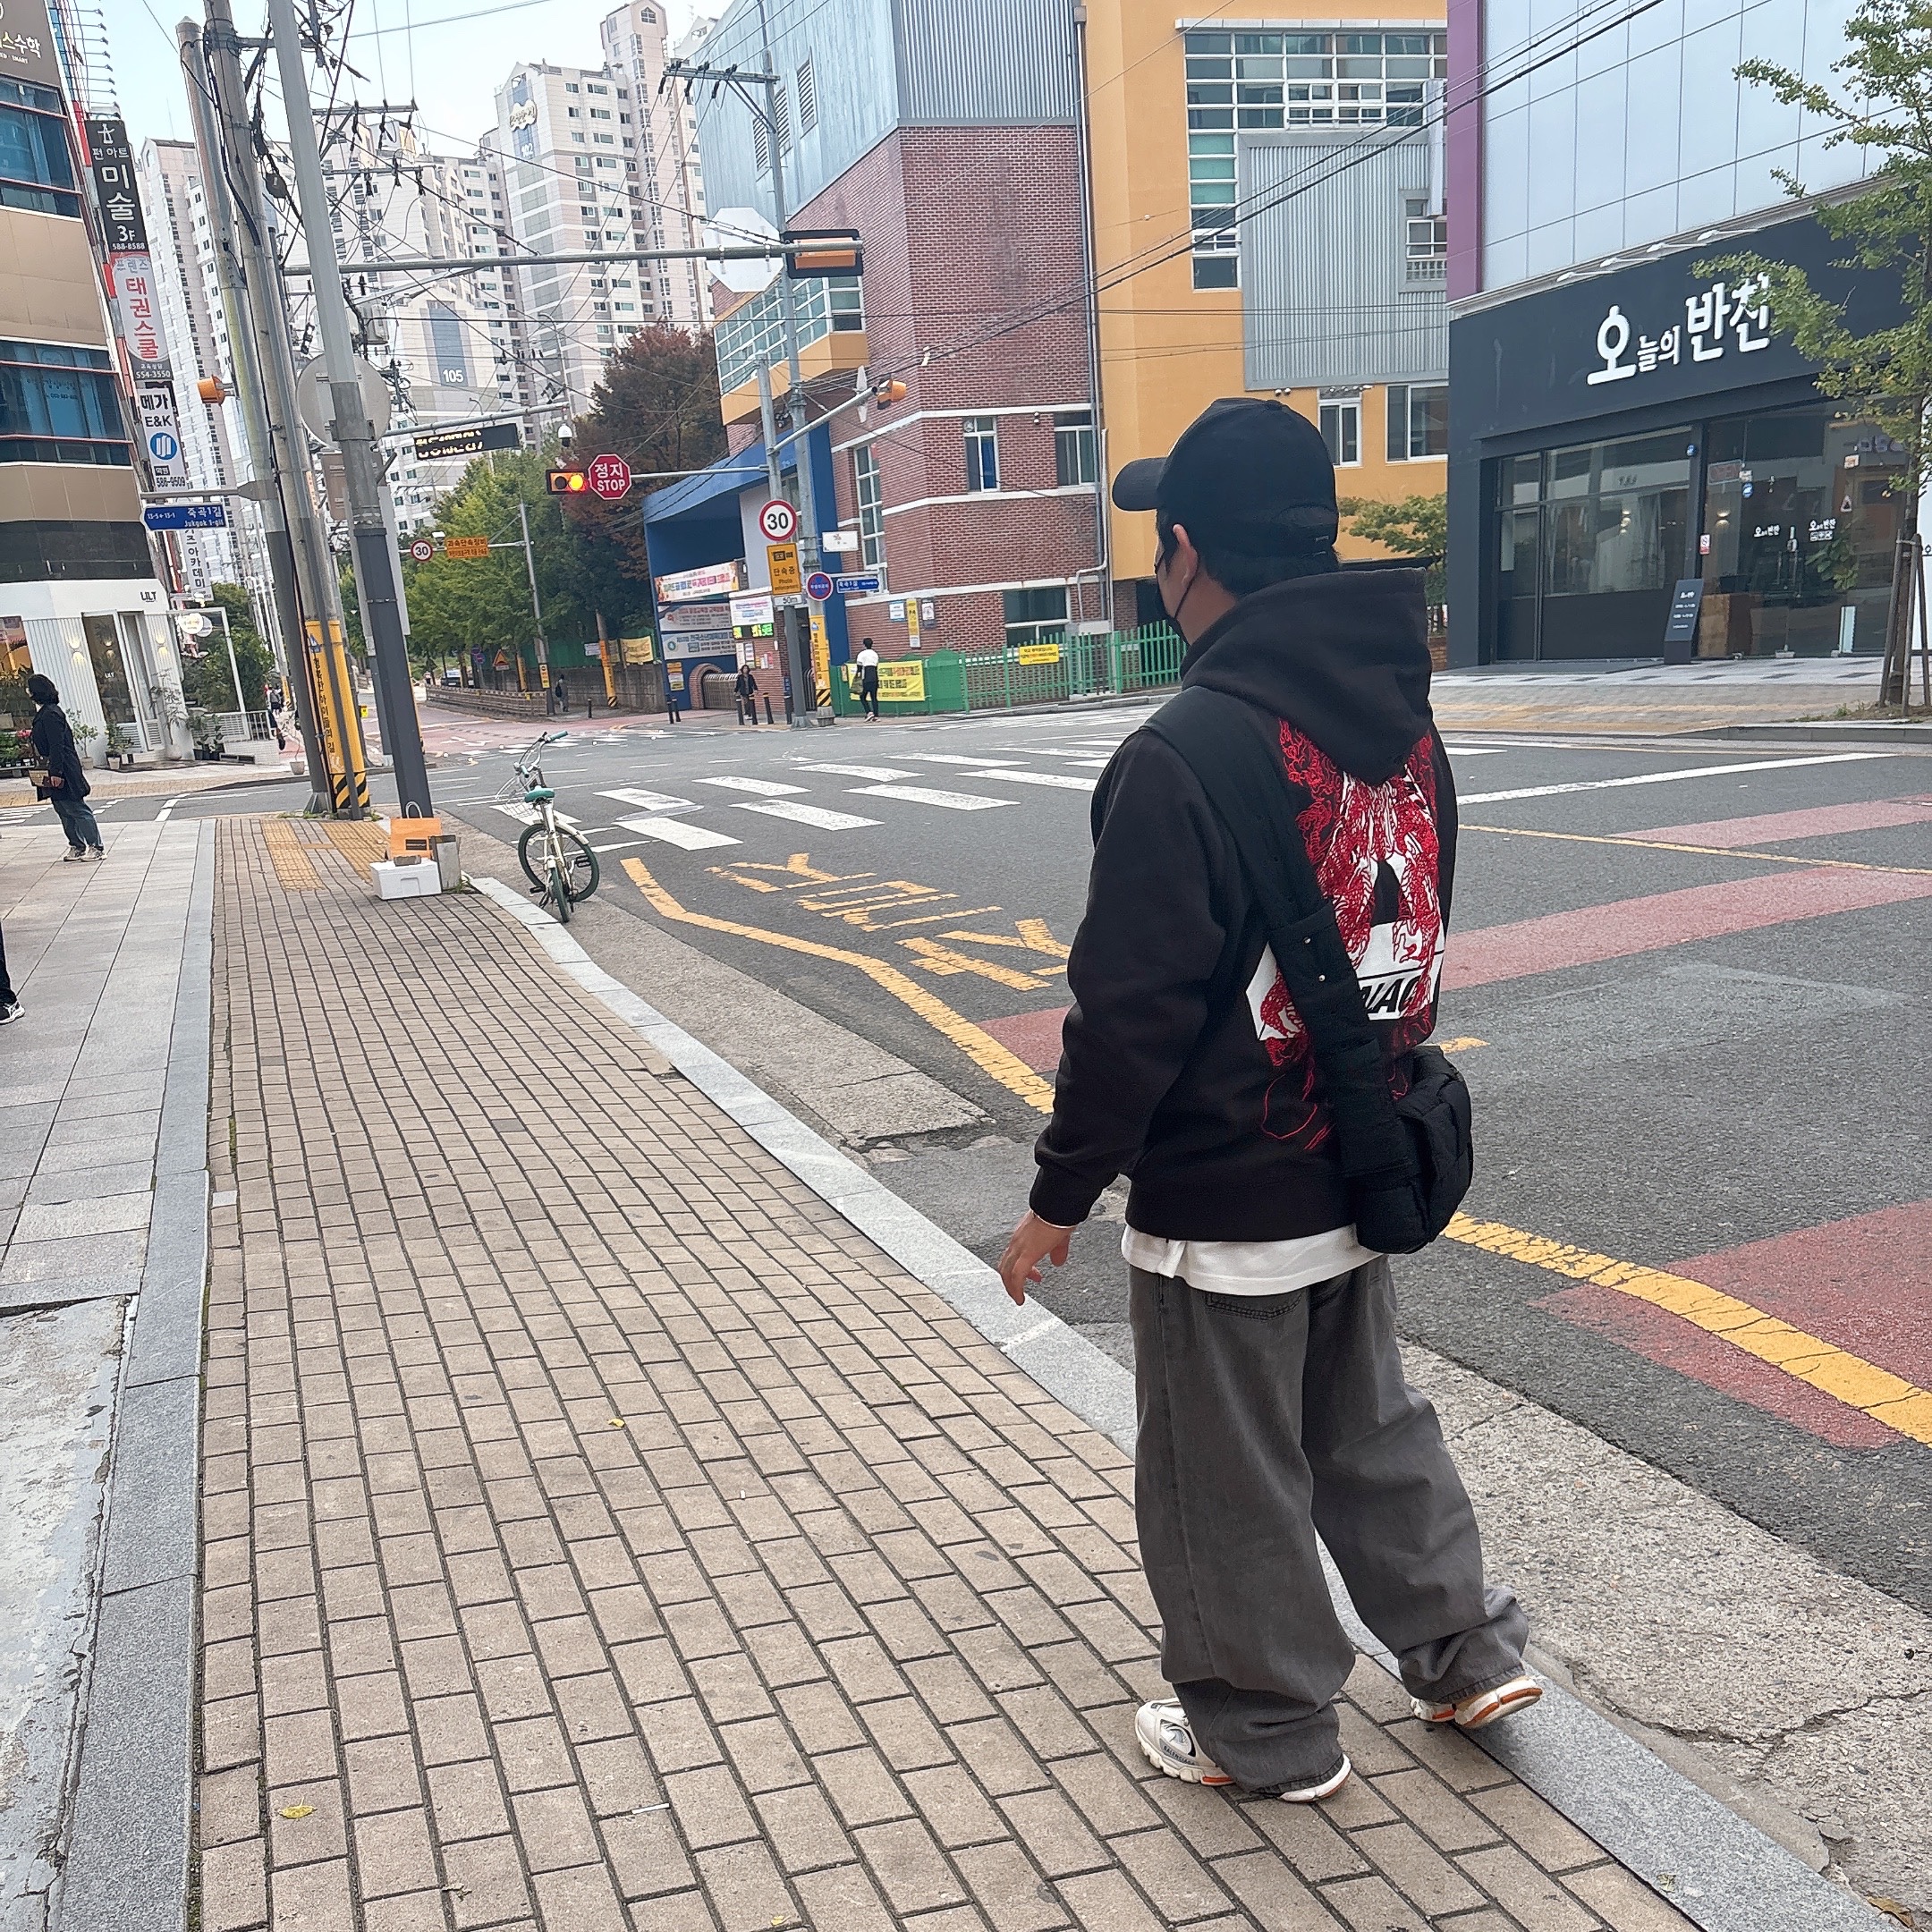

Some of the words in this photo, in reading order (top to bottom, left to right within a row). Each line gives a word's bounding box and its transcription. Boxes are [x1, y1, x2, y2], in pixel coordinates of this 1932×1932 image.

[0, 31, 41, 59] 스수학
[521, 143, 534, 157] 102
[100, 164, 136, 222] 미술
[116, 225, 136, 242] 3F
[125, 276, 159, 360] 태권스쿨
[1587, 304, 1682, 386] 오늘의
[135, 369, 171, 380] 554-3550
[443, 369, 464, 383] 105
[140, 394, 169, 411] 메가
[144, 414, 173, 427] E&K
[595, 462, 624, 479] 정지
[597, 479, 626, 492] STOP
[187, 506, 223, 519] 죽곡1길
[767, 513, 789, 530] 30
[415, 547, 428, 556] 30
[773, 566, 795, 577] 단속중
[782, 597, 798, 605] 50m
[327, 741, 335, 753] 길
